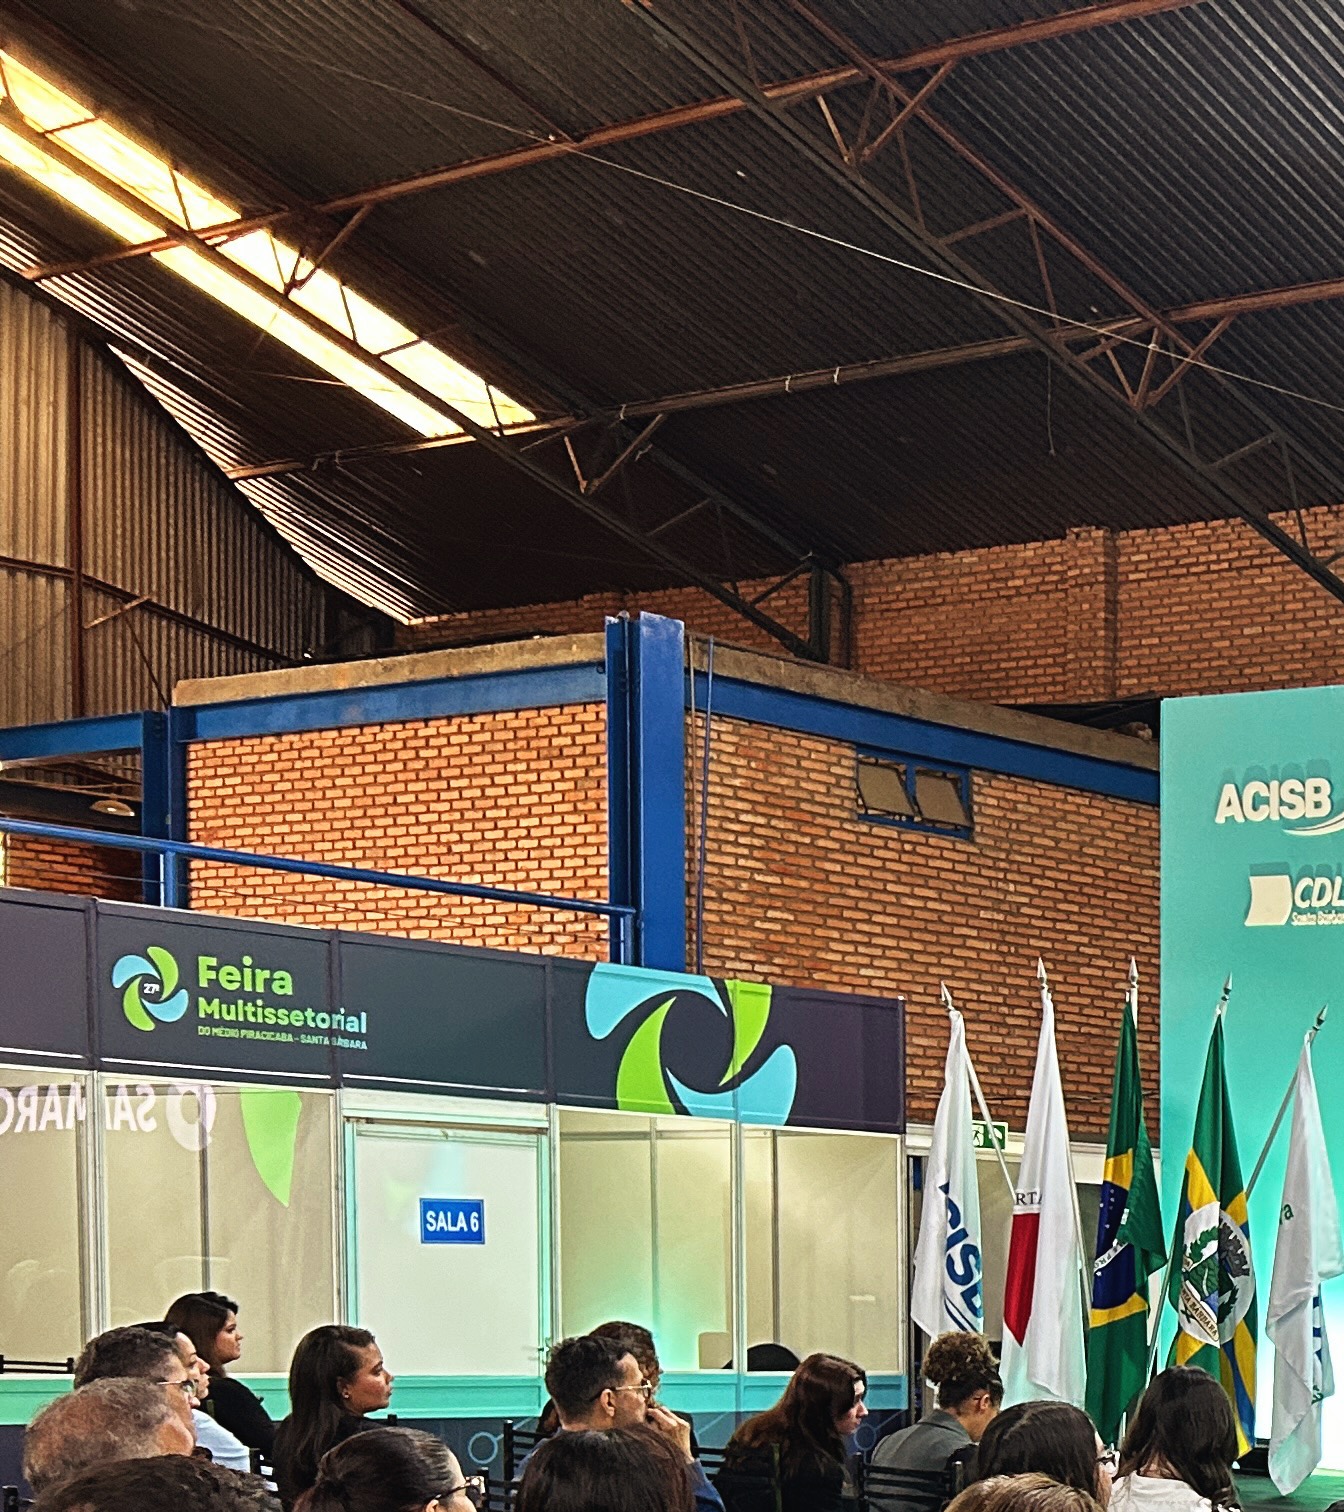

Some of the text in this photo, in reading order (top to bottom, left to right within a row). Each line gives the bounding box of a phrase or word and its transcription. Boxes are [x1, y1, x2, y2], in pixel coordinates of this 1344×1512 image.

[1214, 777, 1332, 824] ACISB
[198, 955, 293, 996] Feira
[198, 996, 368, 1034] Multissetorial
[198, 1025, 211, 1036] DO
[240, 1029, 294, 1043] PIRACICABA
[300, 1034, 330, 1046] SANTA
[425, 1210, 479, 1232] SALA 6
